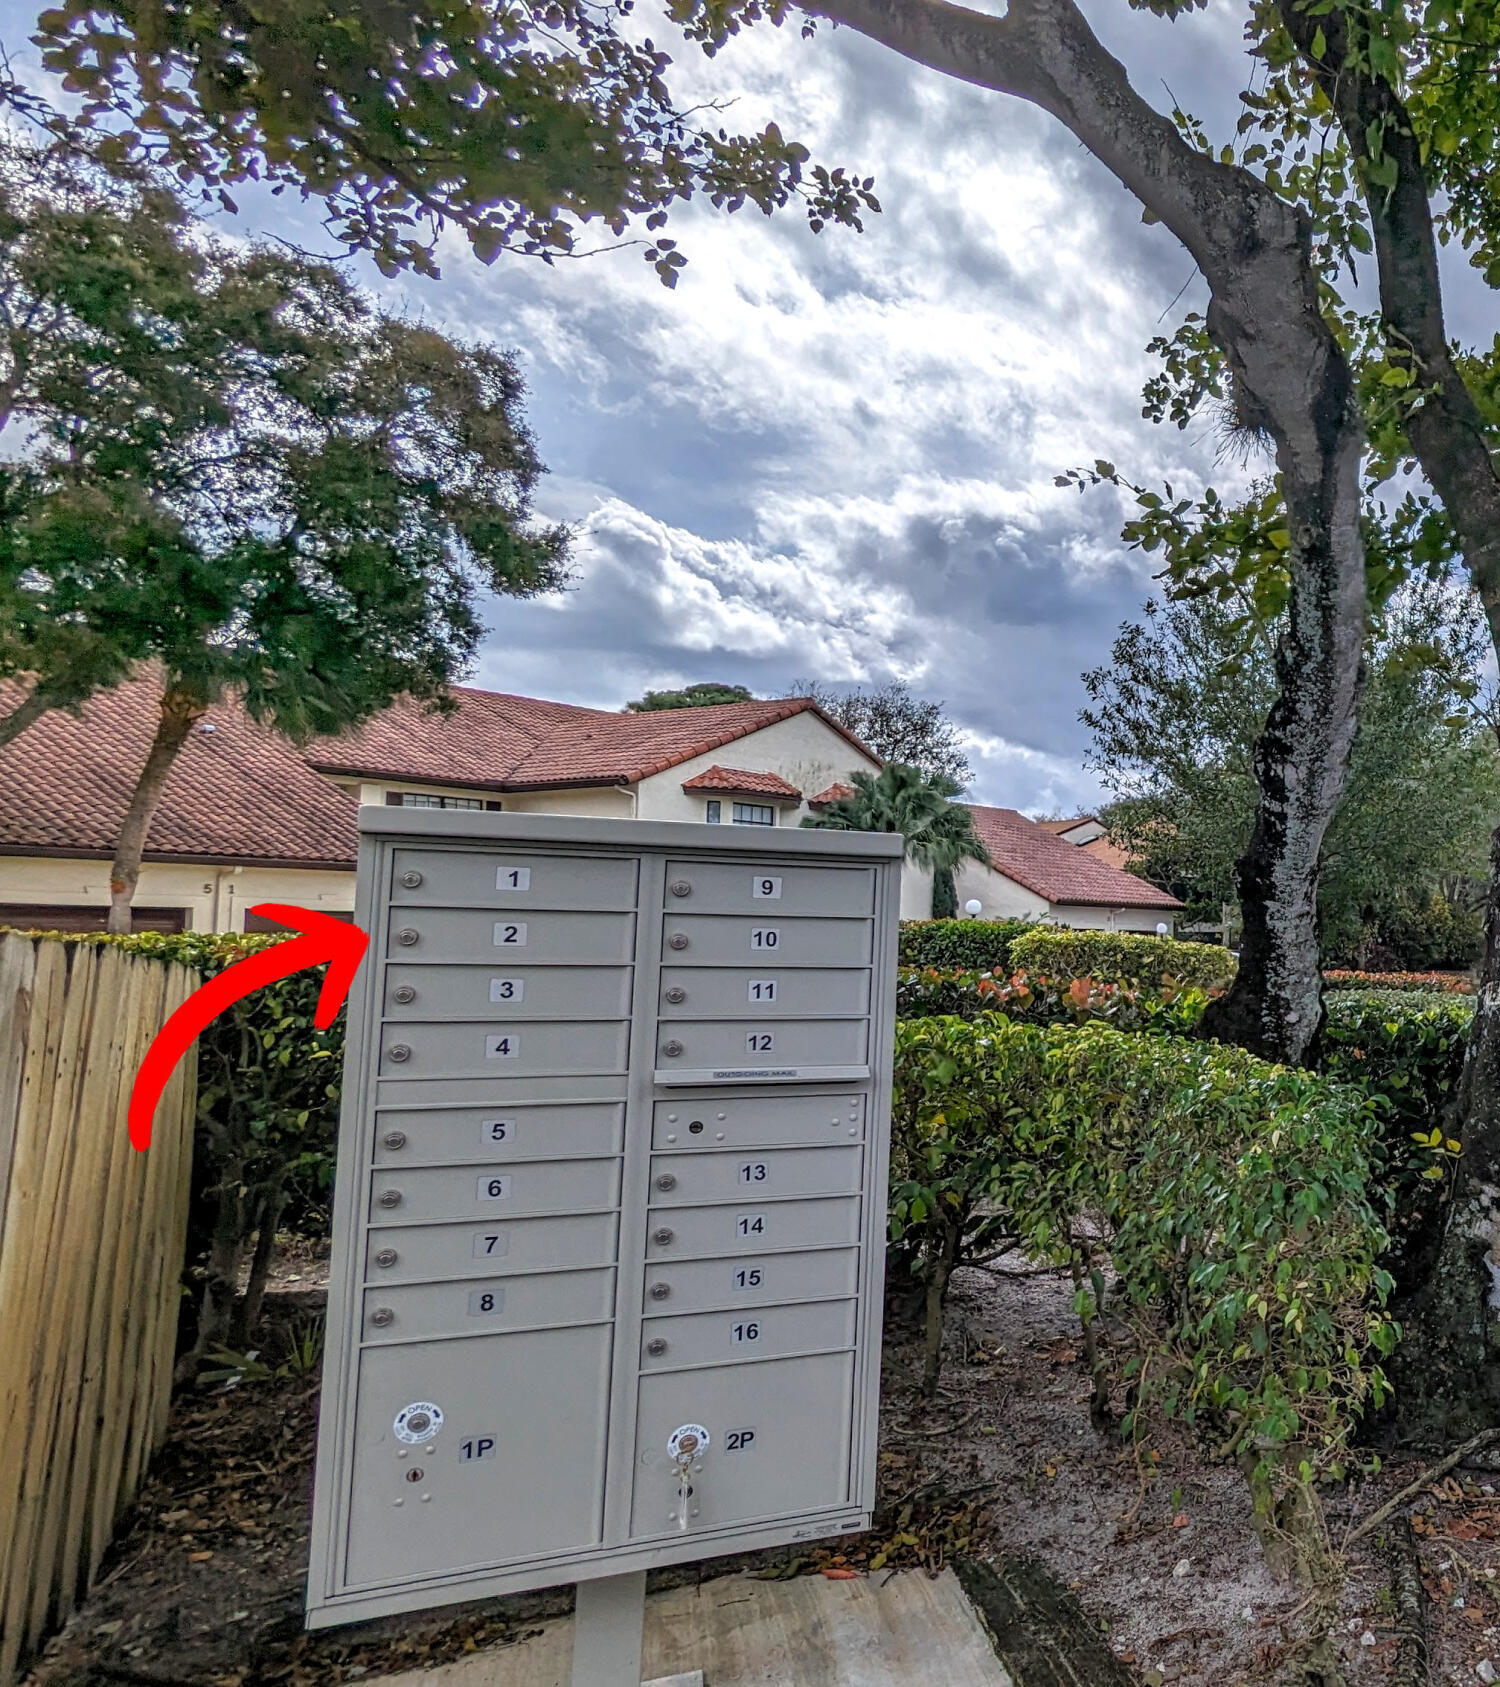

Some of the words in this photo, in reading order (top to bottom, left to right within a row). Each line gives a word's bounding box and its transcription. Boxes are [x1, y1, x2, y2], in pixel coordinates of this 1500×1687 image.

[508, 870, 519, 888] 1
[761, 878, 773, 896] 9
[203, 883, 212, 894] 5
[503, 925, 518, 943] 2
[753, 930, 777, 948] 10
[499, 981, 514, 999] 3
[752, 983, 774, 1000] 11
[495, 1038, 511, 1055] 4
[748, 1034, 772, 1051] 12
[491, 1123, 506, 1141] 5
[741, 1164, 766, 1182] 13
[487, 1179, 502, 1198] 6
[738, 1216, 764, 1235] 14
[484, 1235, 499, 1254] 7
[736, 1269, 761, 1287] 15
[480, 1293, 495, 1312] 8
[734, 1323, 759, 1342] 16
[407, 1403, 433, 1414] OPEN
[461, 1438, 494, 1459] 1P
[727, 1431, 755, 1451] 2P
